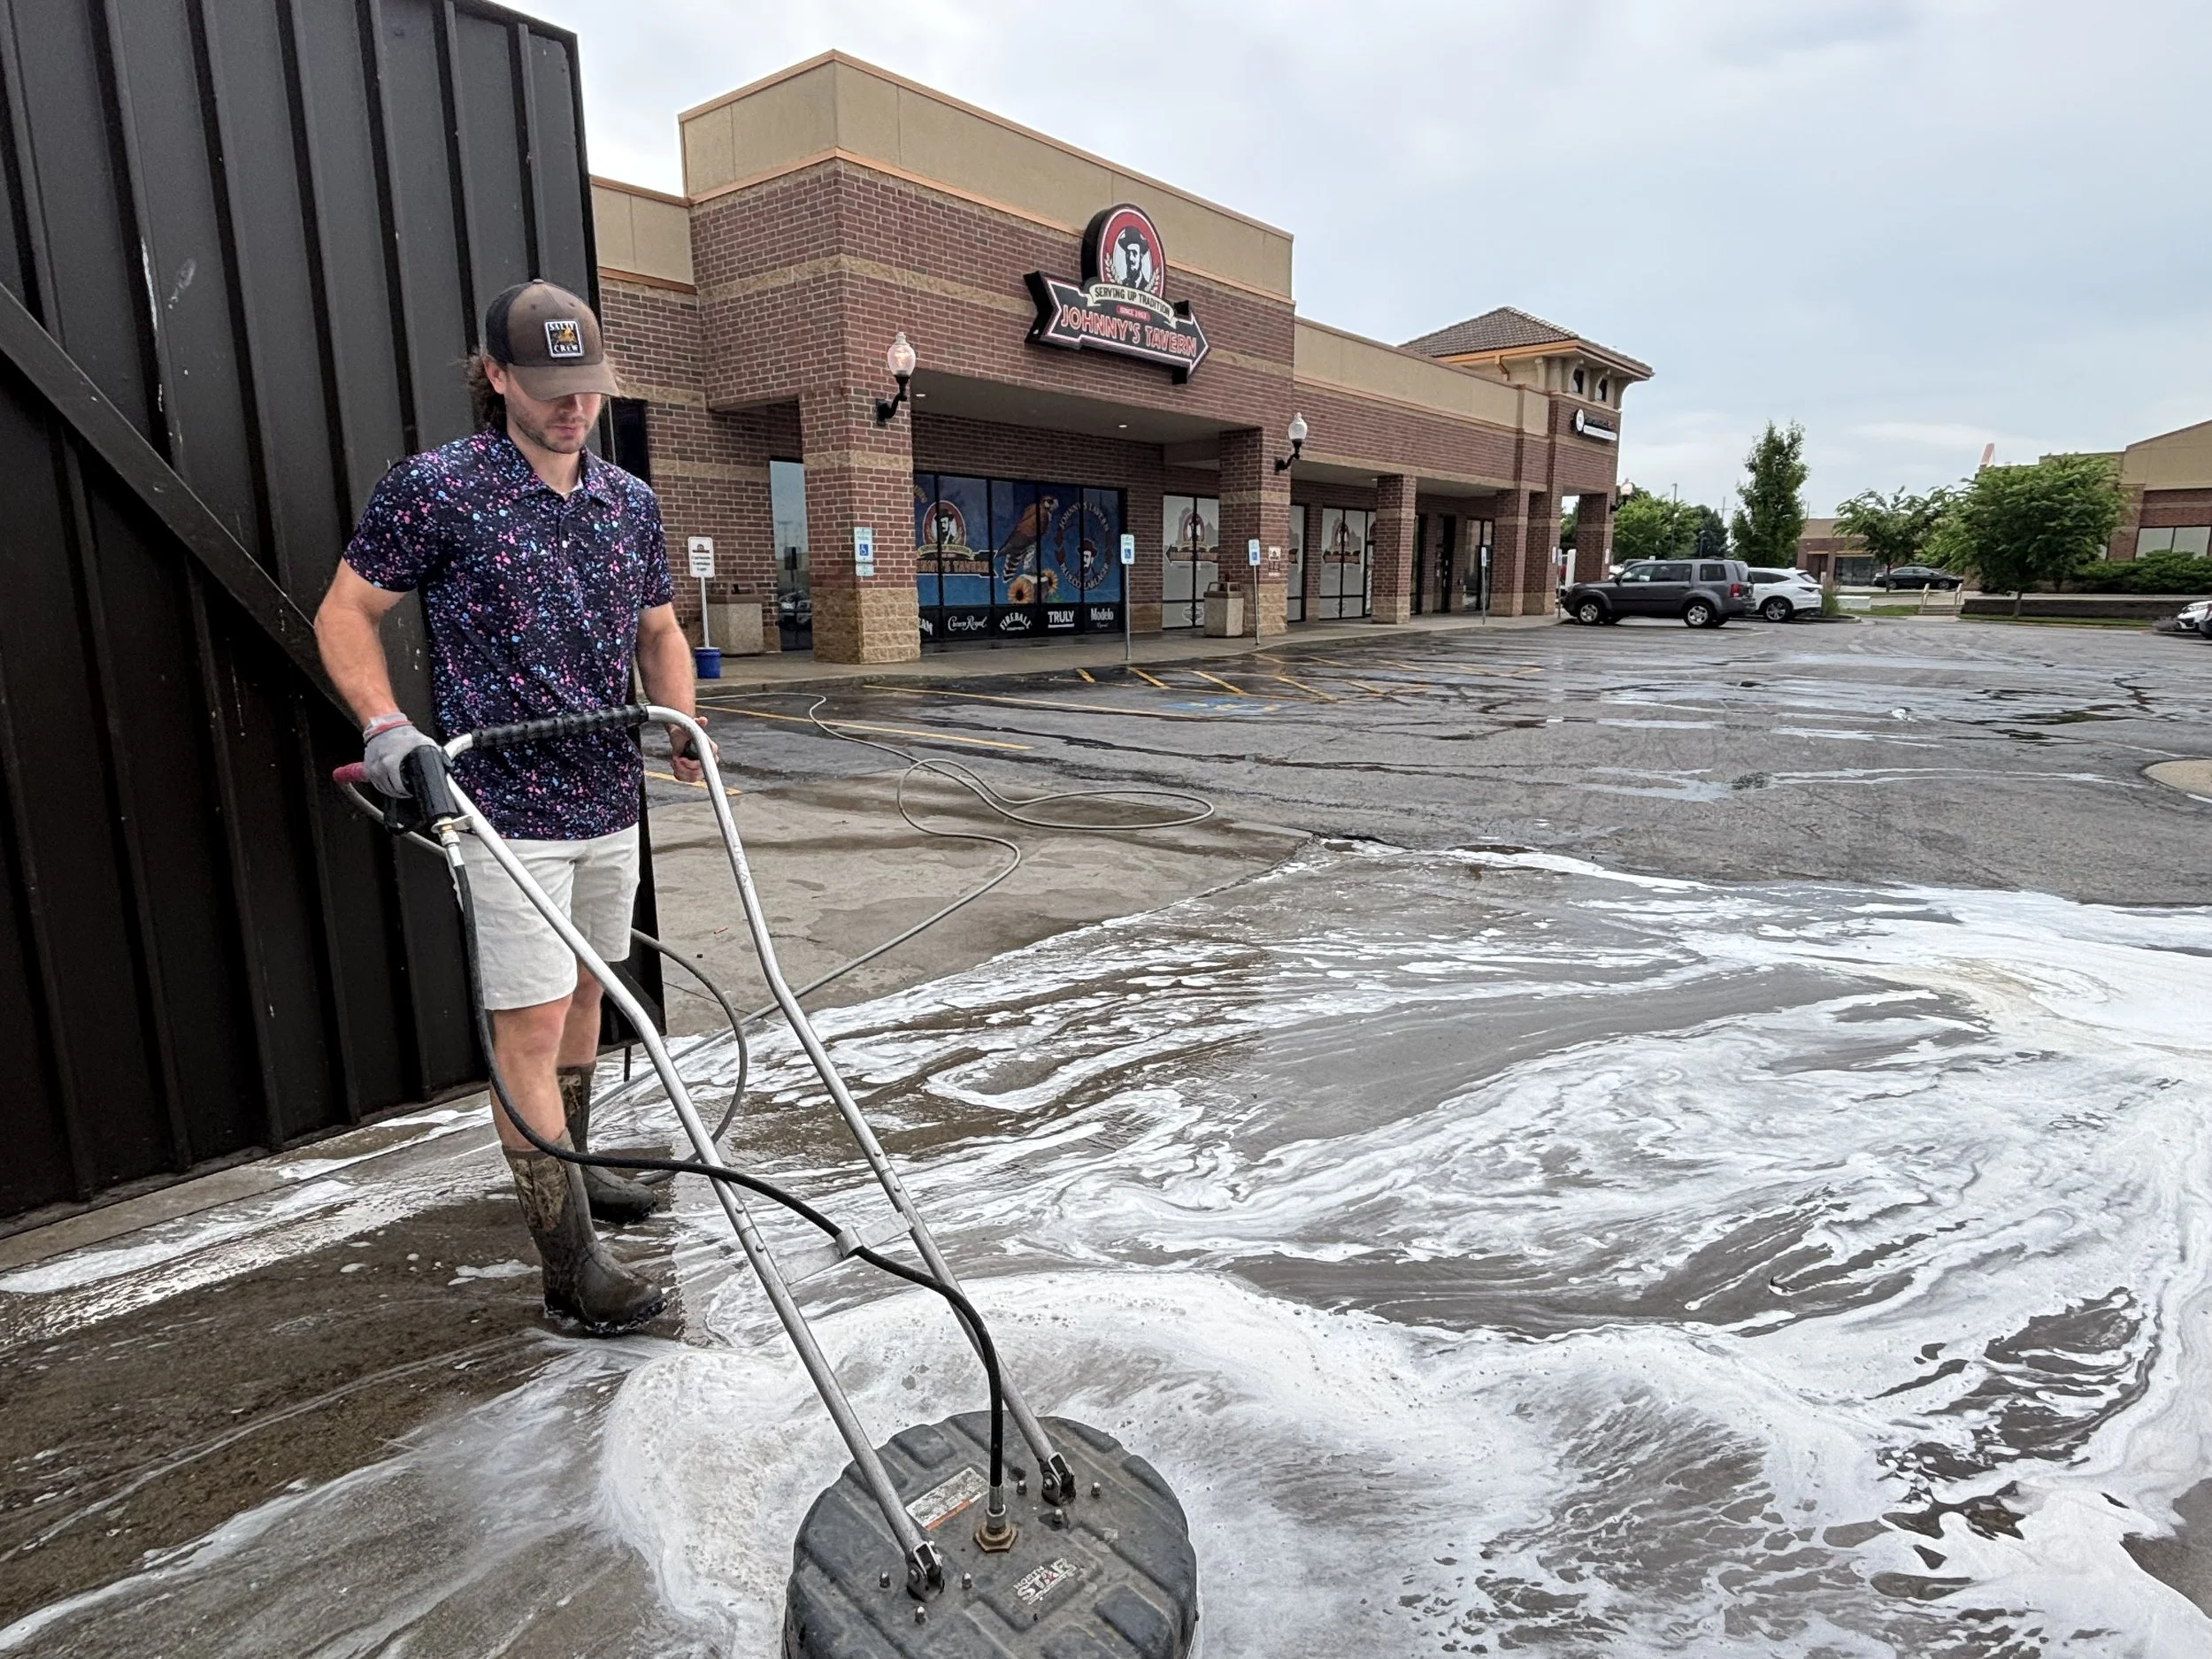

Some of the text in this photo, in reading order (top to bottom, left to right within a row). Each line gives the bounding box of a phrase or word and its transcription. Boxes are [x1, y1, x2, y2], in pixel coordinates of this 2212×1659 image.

[1094, 287, 1171, 315] SERVING UP TRADITION
[1060, 304, 1197, 357] JOHNNY'S TAVERN
[554, 344, 579, 353] CREW
[999, 612, 1032, 630] FIREBALL
[1048, 610, 1074, 623] TRULY
[1090, 607, 1114, 621] Modelo
[1012, 1565, 1045, 1590] NORTH
